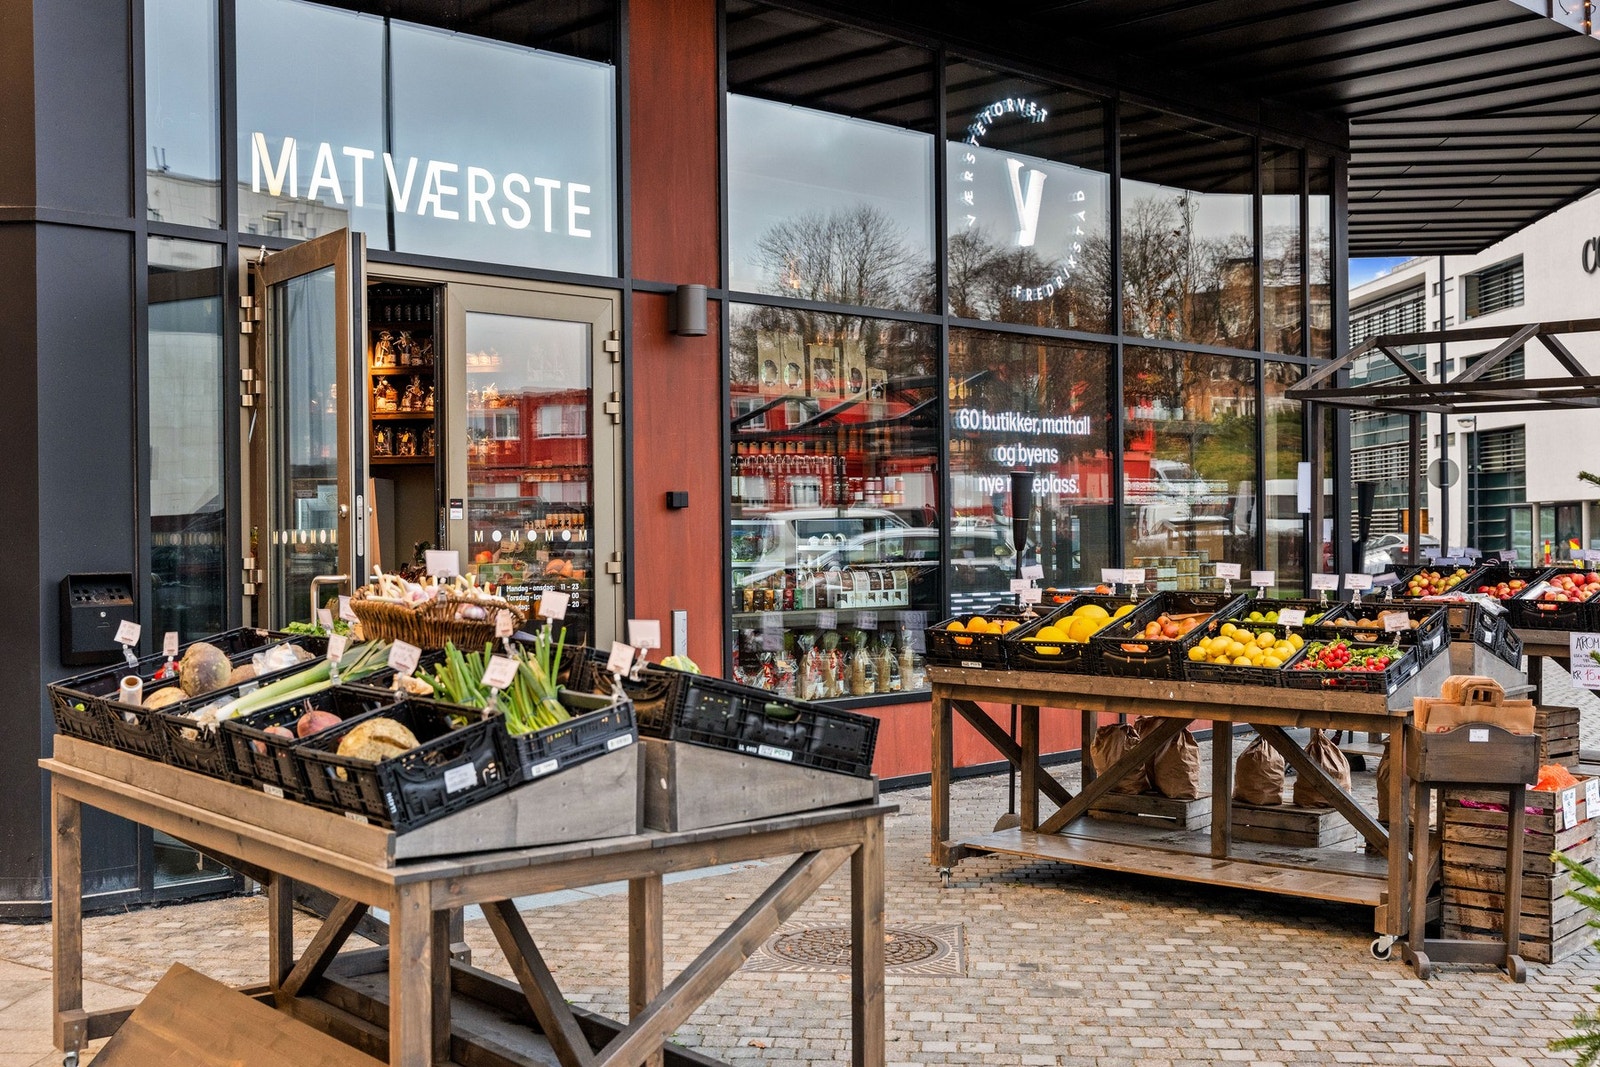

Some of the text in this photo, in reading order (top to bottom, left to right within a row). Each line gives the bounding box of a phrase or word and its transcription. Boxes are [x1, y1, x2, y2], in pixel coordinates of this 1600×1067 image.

[251, 132, 592, 239] MAT VÆRSTE
[1015, 189, 1086, 302] FREDRIKSTAD
[959, 408, 1091, 436] 60 butikker, mathall
[997, 443, 1059, 467] og byens
[978, 474, 1004, 497] nye
[506, 585, 528, 593] Mandag
[506, 594, 529, 602] Torsdag
